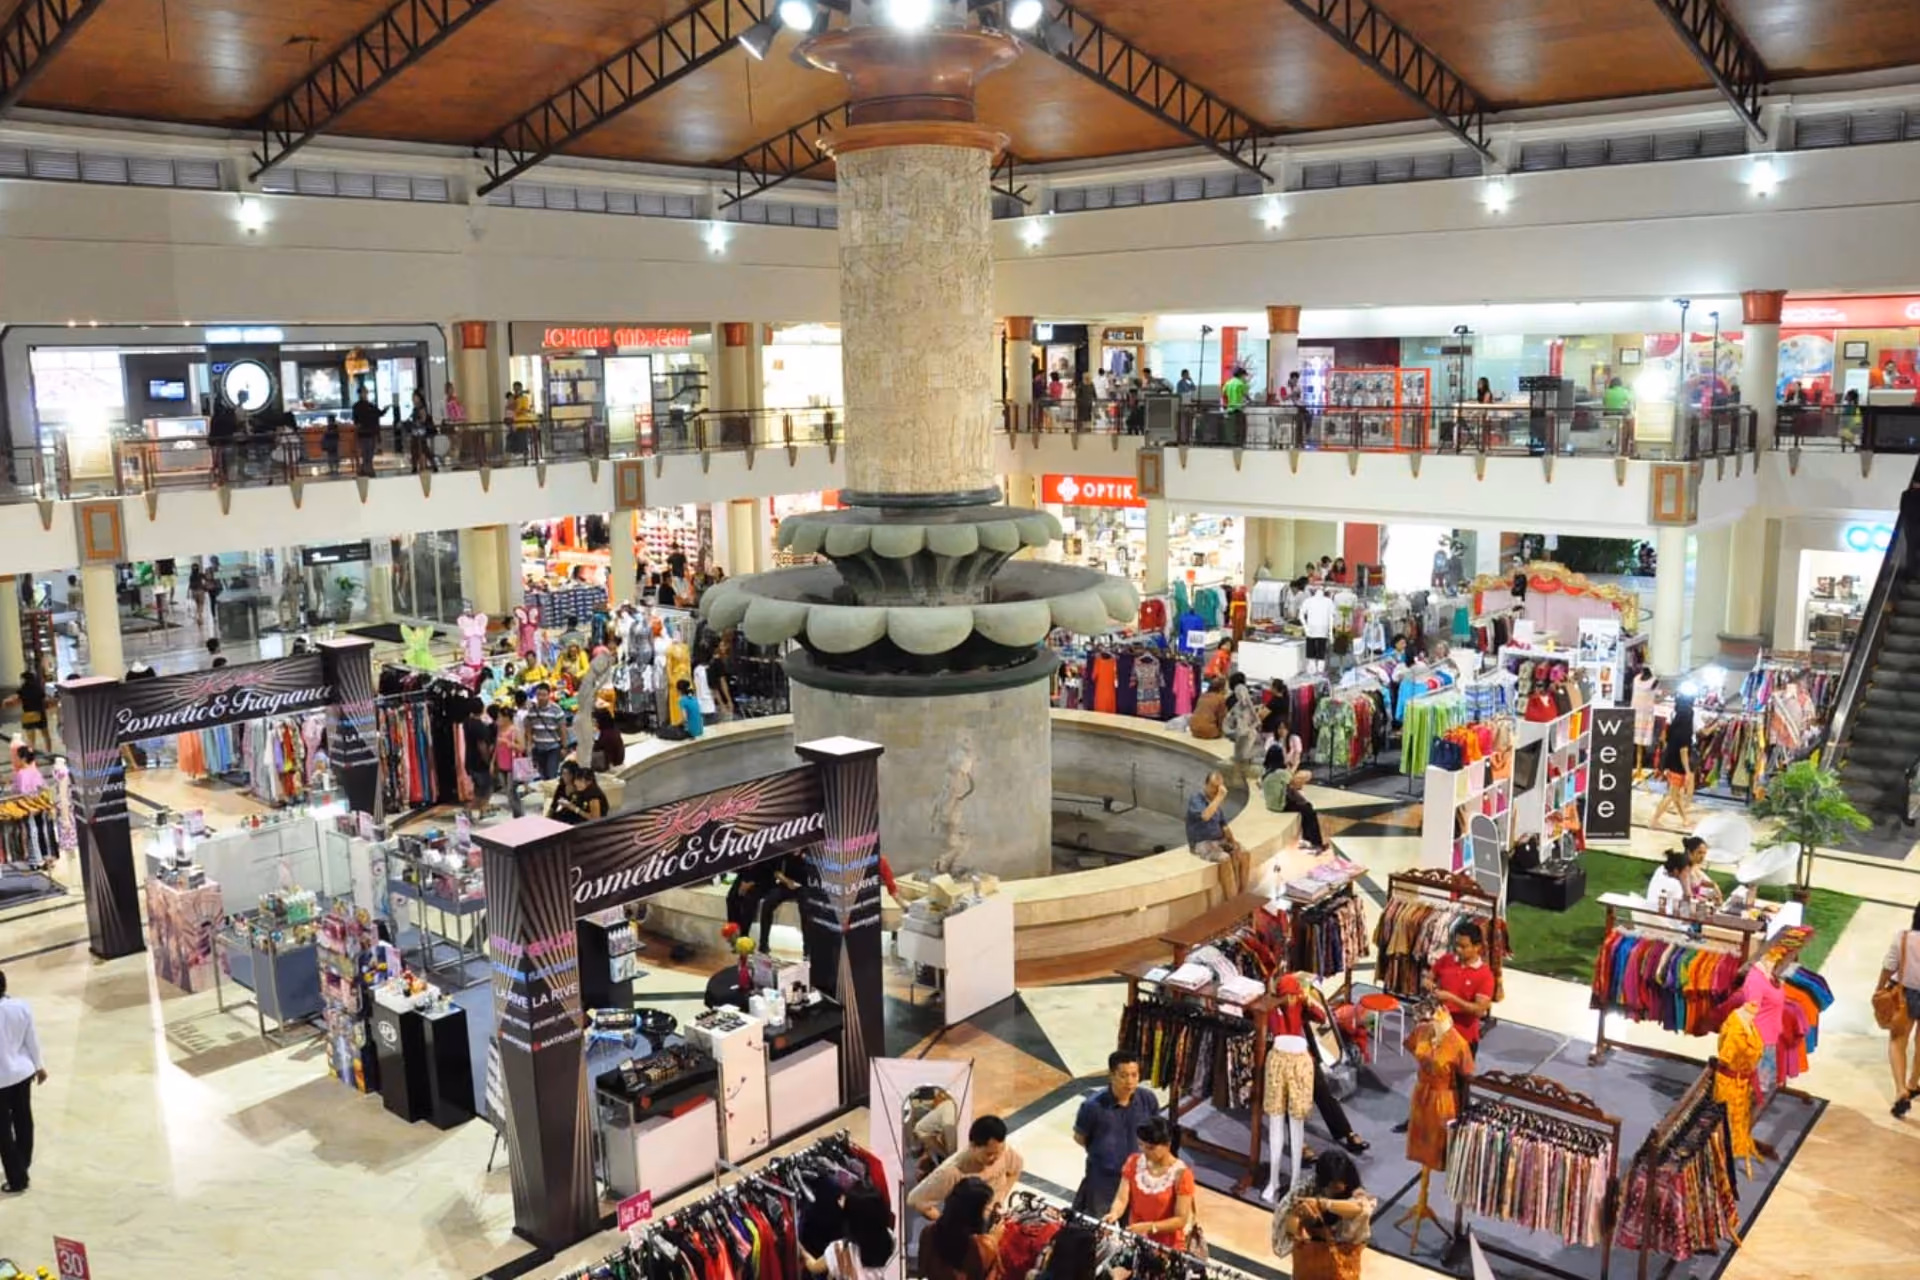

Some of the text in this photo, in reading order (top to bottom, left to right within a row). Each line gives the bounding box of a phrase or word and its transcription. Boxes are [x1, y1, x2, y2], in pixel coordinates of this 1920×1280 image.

[1082, 482, 1133, 500] OPTIK
[208, 694, 230, 719] &
[1597, 719, 1622, 818] webe
[680, 836, 704, 870] &
[532, 982, 579, 1009] LA RIVE
[59, 1250, 84, 1277] 30
